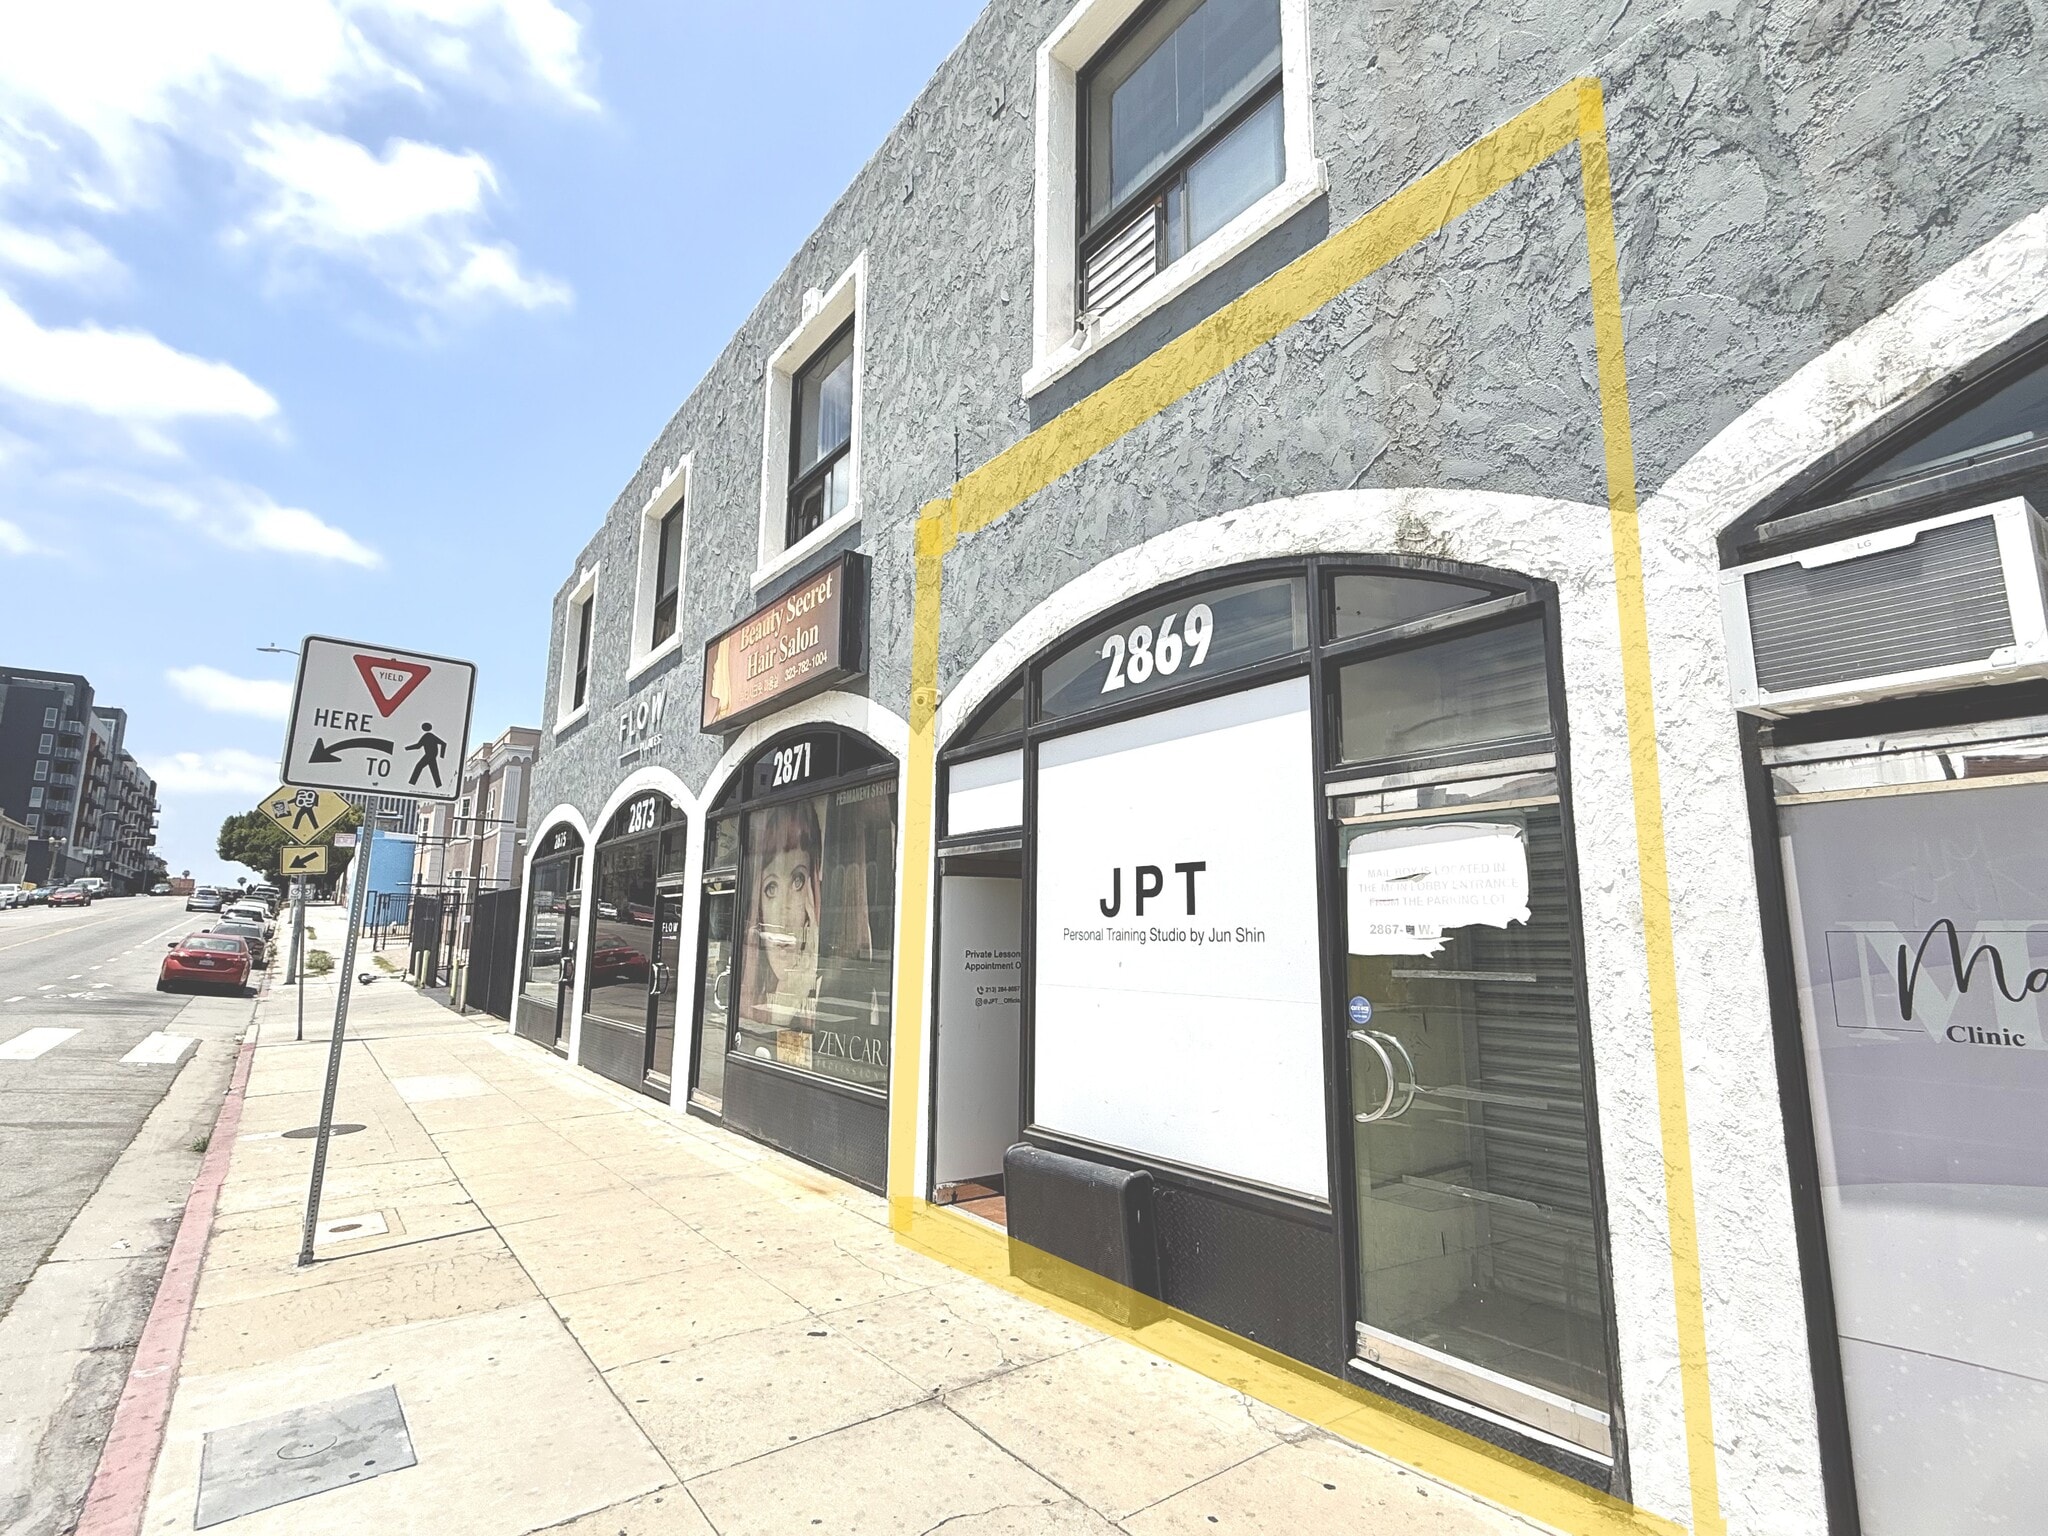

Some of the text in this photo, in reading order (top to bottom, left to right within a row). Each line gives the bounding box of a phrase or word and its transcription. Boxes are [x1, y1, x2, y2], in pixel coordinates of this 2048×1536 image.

[1857, 540, 1872, 549] LG
[740, 572, 833, 652] Beauty Secret
[746, 624, 819, 681] Hair Salon
[1101, 603, 1214, 694] 2869
[784, 650, 828, 681] 323-782-1004
[379, 671, 404, 683] YIELD
[314, 708, 373, 733] HERE
[619, 689, 667, 742] FLOW
[366, 757, 391, 778] TO
[772, 742, 811, 787] 2871
[836, 785, 871, 807] PERMANENT
[628, 797, 655, 833] 2873
[1367, 868, 1391, 879] MAIL
[1434, 863, 1489, 875] LOCATED
[1493, 862, 1506, 873] IN
[1100, 861, 1206, 918] JPT
[1358, 883, 1377, 893] THE
[1410, 881, 1449, 892] LOBBY
[1452, 878, 1519, 890] ENTRANCE
[1402, 897, 1424, 907] THE
[1427, 895, 1480, 907] PARKING
[1483, 894, 1506, 905] LOT
[662, 922, 679, 933] FLOW
[1063, 926, 1265, 945] Personal Training Studio by Jun Shin
[1418, 924, 1434, 935] W.
[965, 949, 992, 959] Private
[965, 961, 1014, 972] Appointment
[817, 1030, 846, 1058] ZEN
[1946, 1025, 2027, 1047] Clinic
